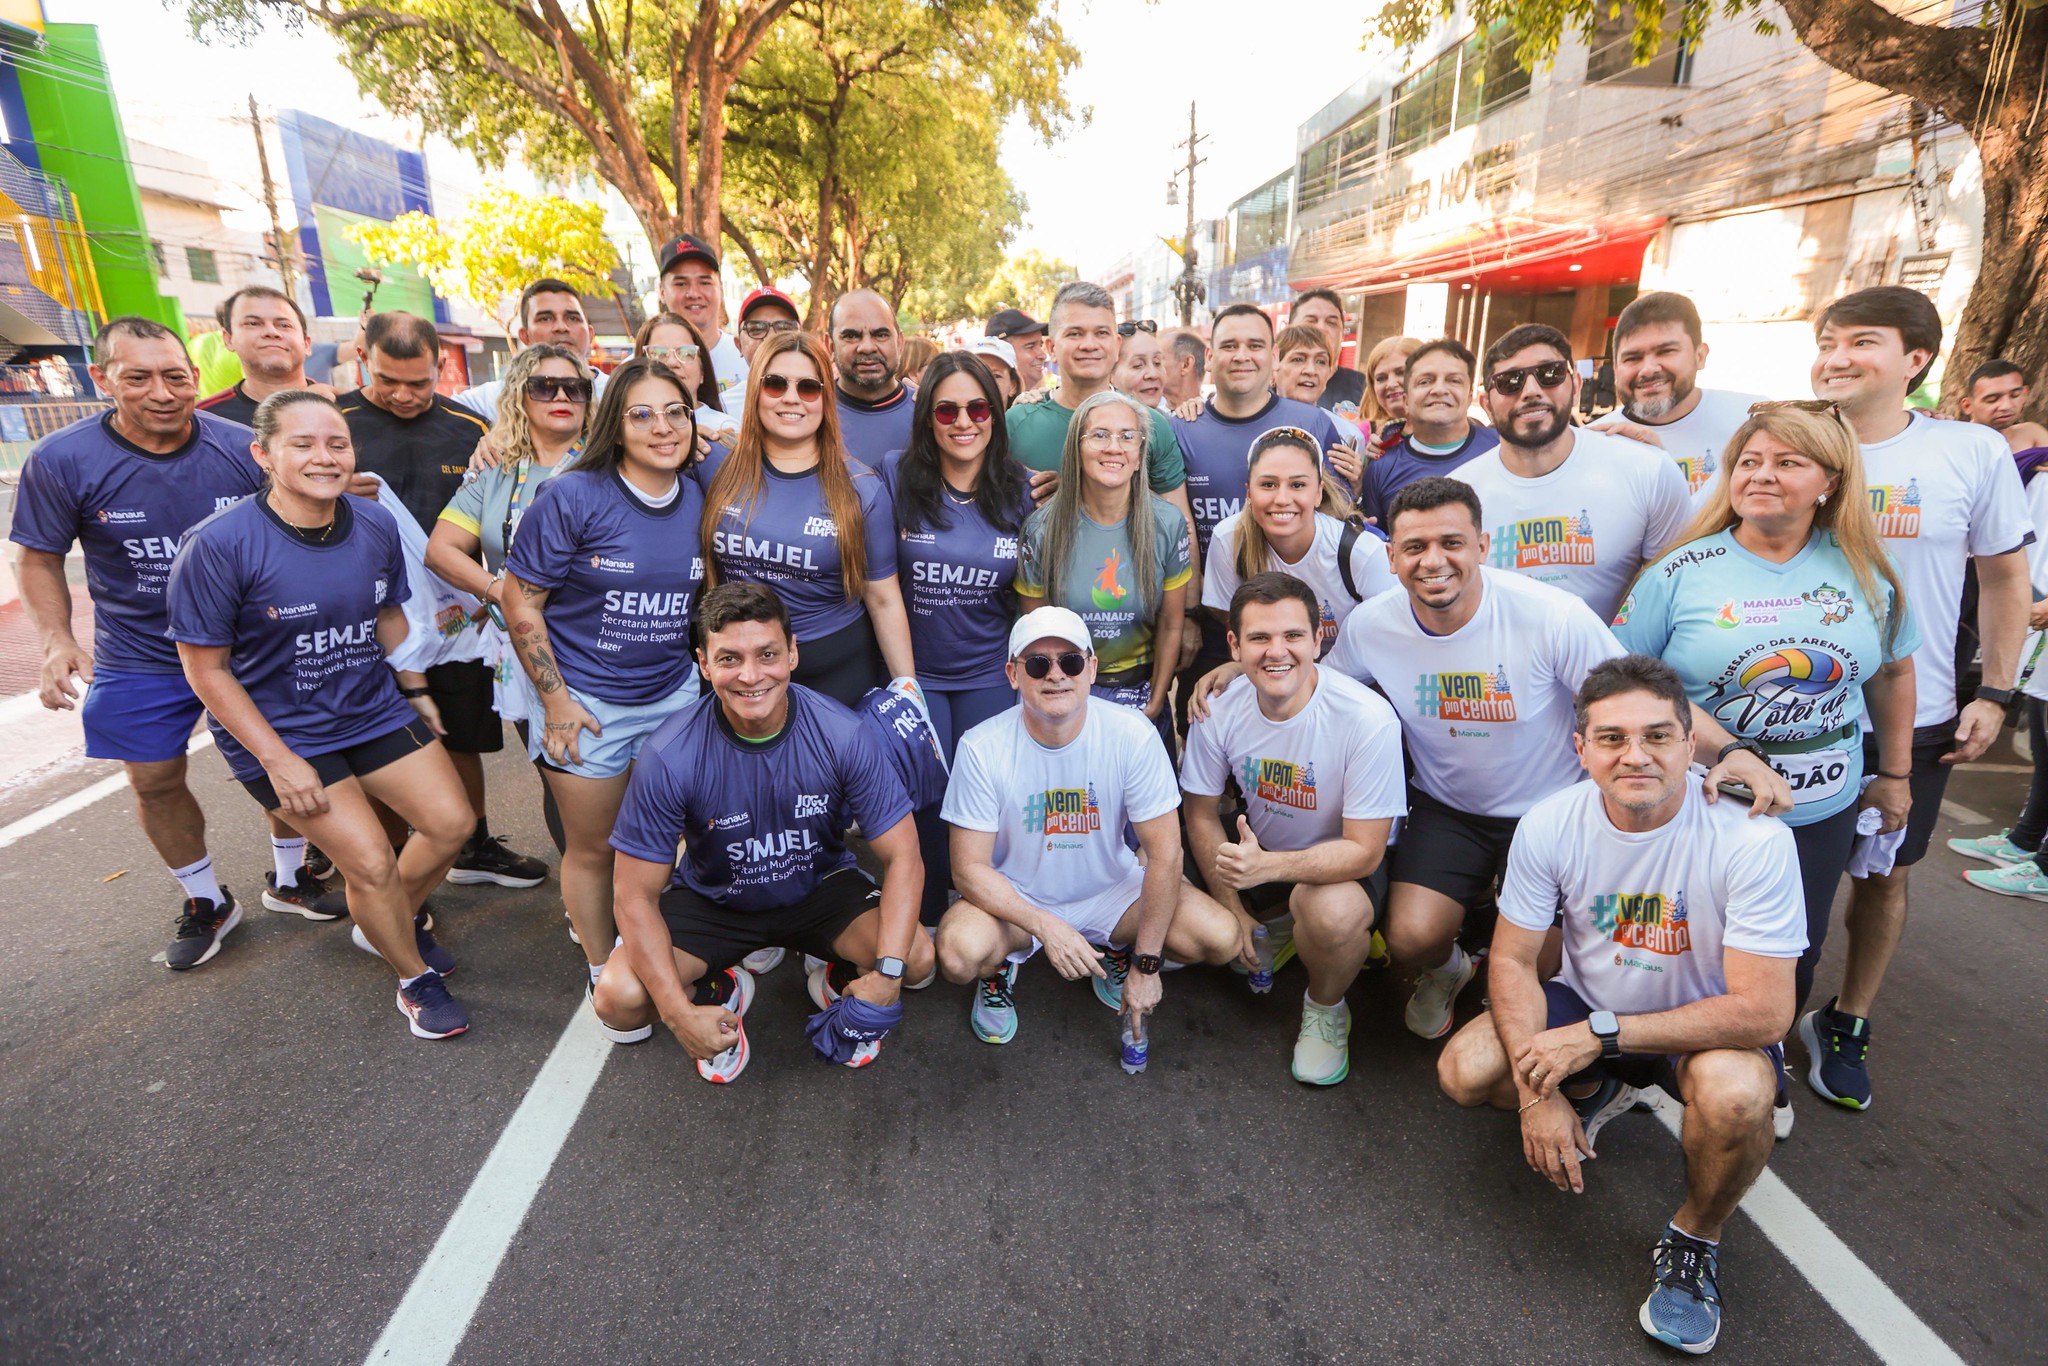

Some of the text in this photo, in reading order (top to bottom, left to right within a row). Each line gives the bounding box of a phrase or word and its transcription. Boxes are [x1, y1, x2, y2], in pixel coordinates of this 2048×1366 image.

[107, 510, 146, 519] Manaus
[1192, 497, 1240, 520] SEM
[1872, 506, 1919, 536] ntro
[122, 536, 183, 559] SEM
[712, 531, 819, 571] SEMJEL
[1522, 536, 1593, 564] pro centro
[131, 560, 171, 571] Secretar
[600, 557, 635, 569] Manaus
[137, 571, 170, 582] Juvent
[912, 561, 999, 588] SEMJEL
[137, 583, 162, 594] Lazer
[913, 582, 951, 595] Secretaria
[603, 590, 690, 616] SEMJEL
[913, 594, 953, 606] Juventude
[1743, 597, 1802, 608] MANAUS
[278, 602, 317, 616] Manaus
[913, 605, 932, 616] Lazer
[601, 612, 648, 629] Secretaria
[650, 618, 683, 630] Municipal
[1082, 612, 1135, 622] MANAUS
[1744, 615, 1778, 624] 2024
[599, 626, 648, 642] Juventude
[650, 631, 677, 644] Esporte
[1093, 628, 1121, 639] 2024
[596, 638, 622, 652] Lazer
[1724, 637, 1859, 682] DESAFIO DAS ARENAS 2024
[296, 680, 323, 691] Lazer
[1444, 694, 1515, 720] pro centro
[1713, 684, 1816, 733] Vôlei
[1262, 784, 1315, 809] pro centro
[715, 811, 749, 826] Manaus
[1059, 808, 1099, 832] cento
[769, 852, 812, 870] Municipal
[772, 863, 807, 882] Esporte
[1623, 958, 1664, 972] Manaus
